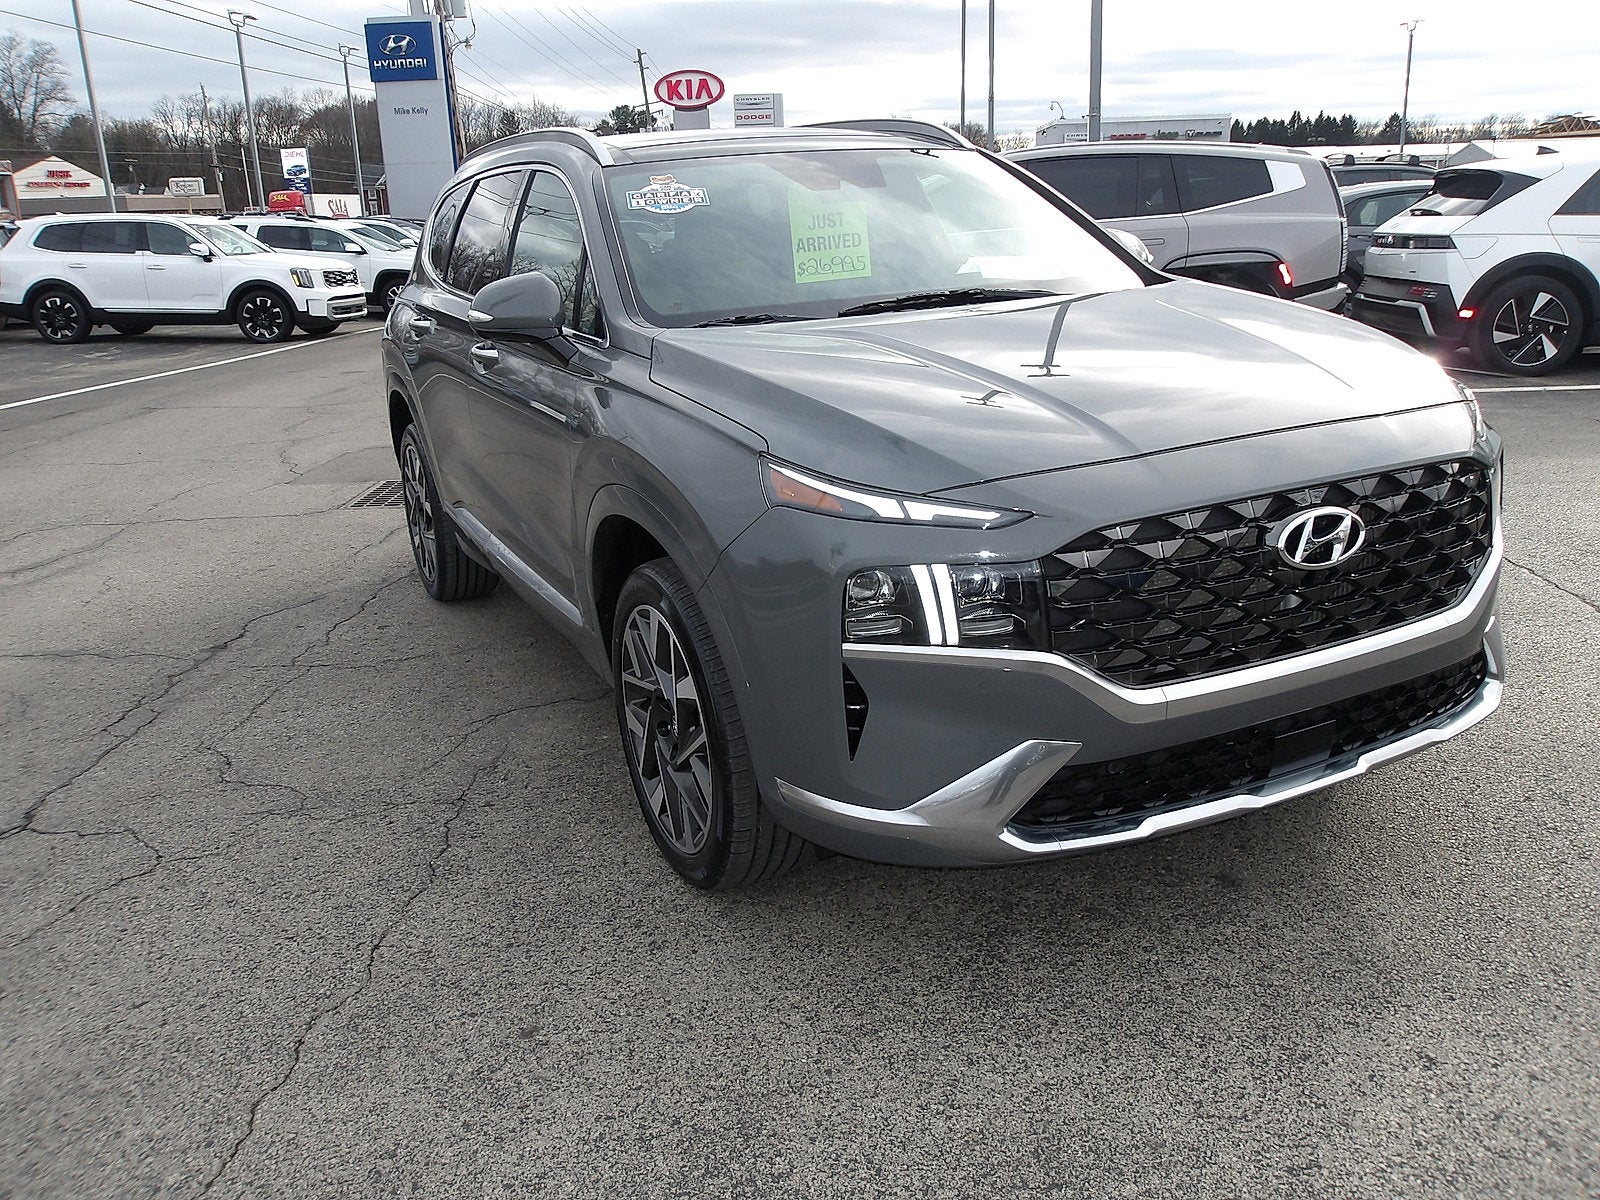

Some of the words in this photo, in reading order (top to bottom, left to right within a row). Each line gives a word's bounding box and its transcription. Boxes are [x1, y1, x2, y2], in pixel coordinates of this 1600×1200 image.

[373, 58, 427, 70] HYUNDAI
[665, 78, 714, 101] KIA
[393, 107, 411, 116] Mike
[411, 106, 429, 116] Kelly
[631, 191, 702, 200] CARFAX
[645, 197, 705, 205] OWNER
[807, 211, 845, 231] JUST
[796, 232, 862, 253] ARRIVED
[797, 255, 866, 277] $26,995
